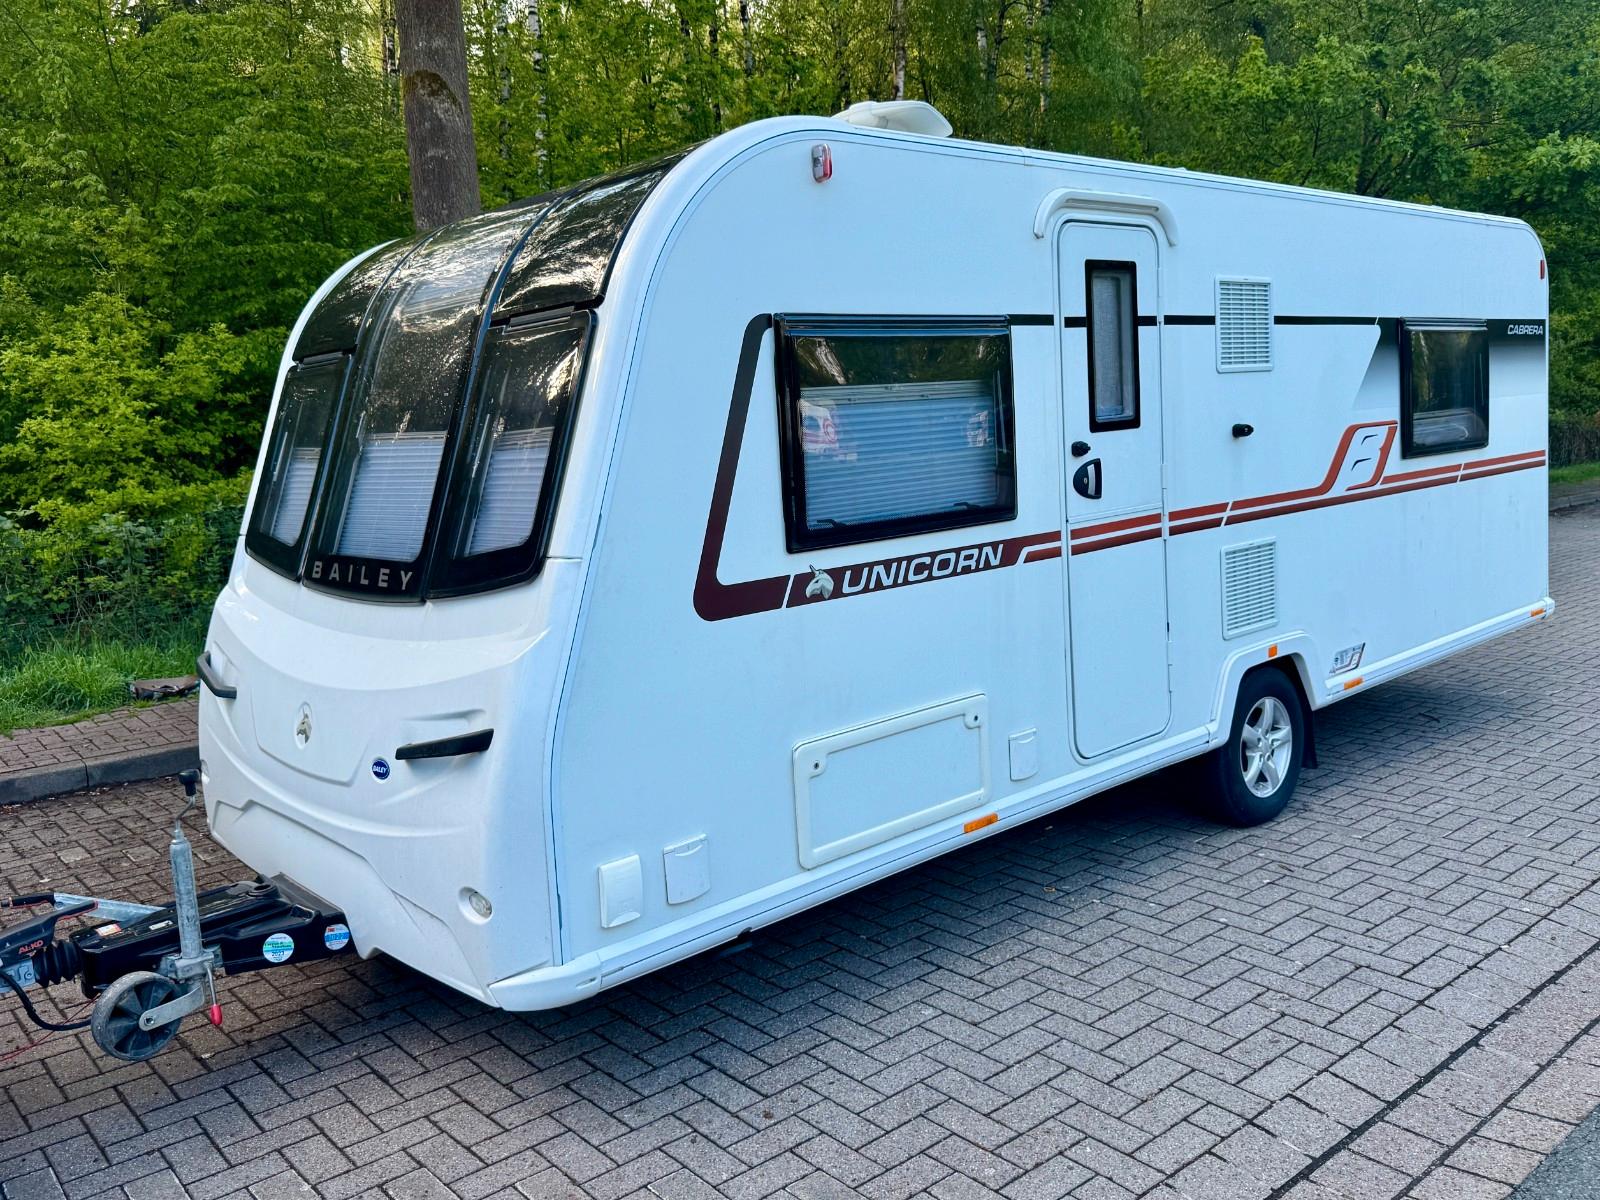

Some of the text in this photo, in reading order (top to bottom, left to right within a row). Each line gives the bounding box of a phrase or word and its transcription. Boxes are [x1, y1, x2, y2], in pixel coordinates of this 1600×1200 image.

[1507, 324, 1543, 335] CABRERA
[311, 560, 413, 591] BAILEY
[842, 544, 1004, 595] UNICORN
